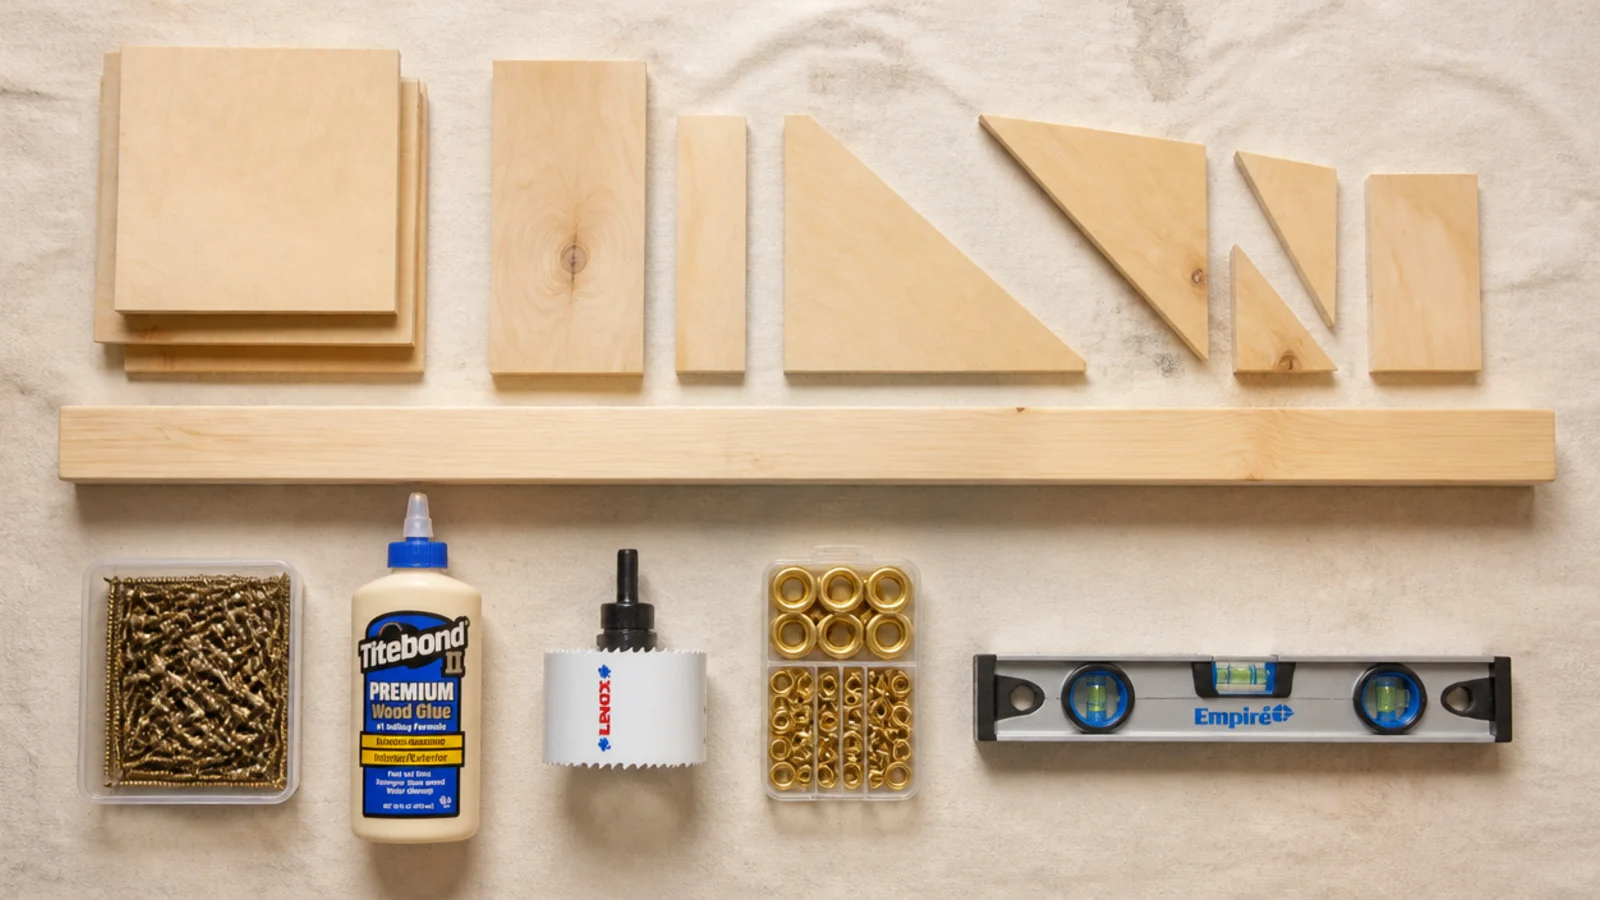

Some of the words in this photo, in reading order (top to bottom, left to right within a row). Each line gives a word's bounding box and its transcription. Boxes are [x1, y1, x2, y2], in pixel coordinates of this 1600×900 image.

[360, 620, 465, 669] Titebond
[445, 651, 463, 674] II
[369, 682, 454, 701] PREMIUM
[372, 703, 412, 719] Wood
[416, 703, 452, 719] Glue
[599, 680, 611, 736] LENOX
